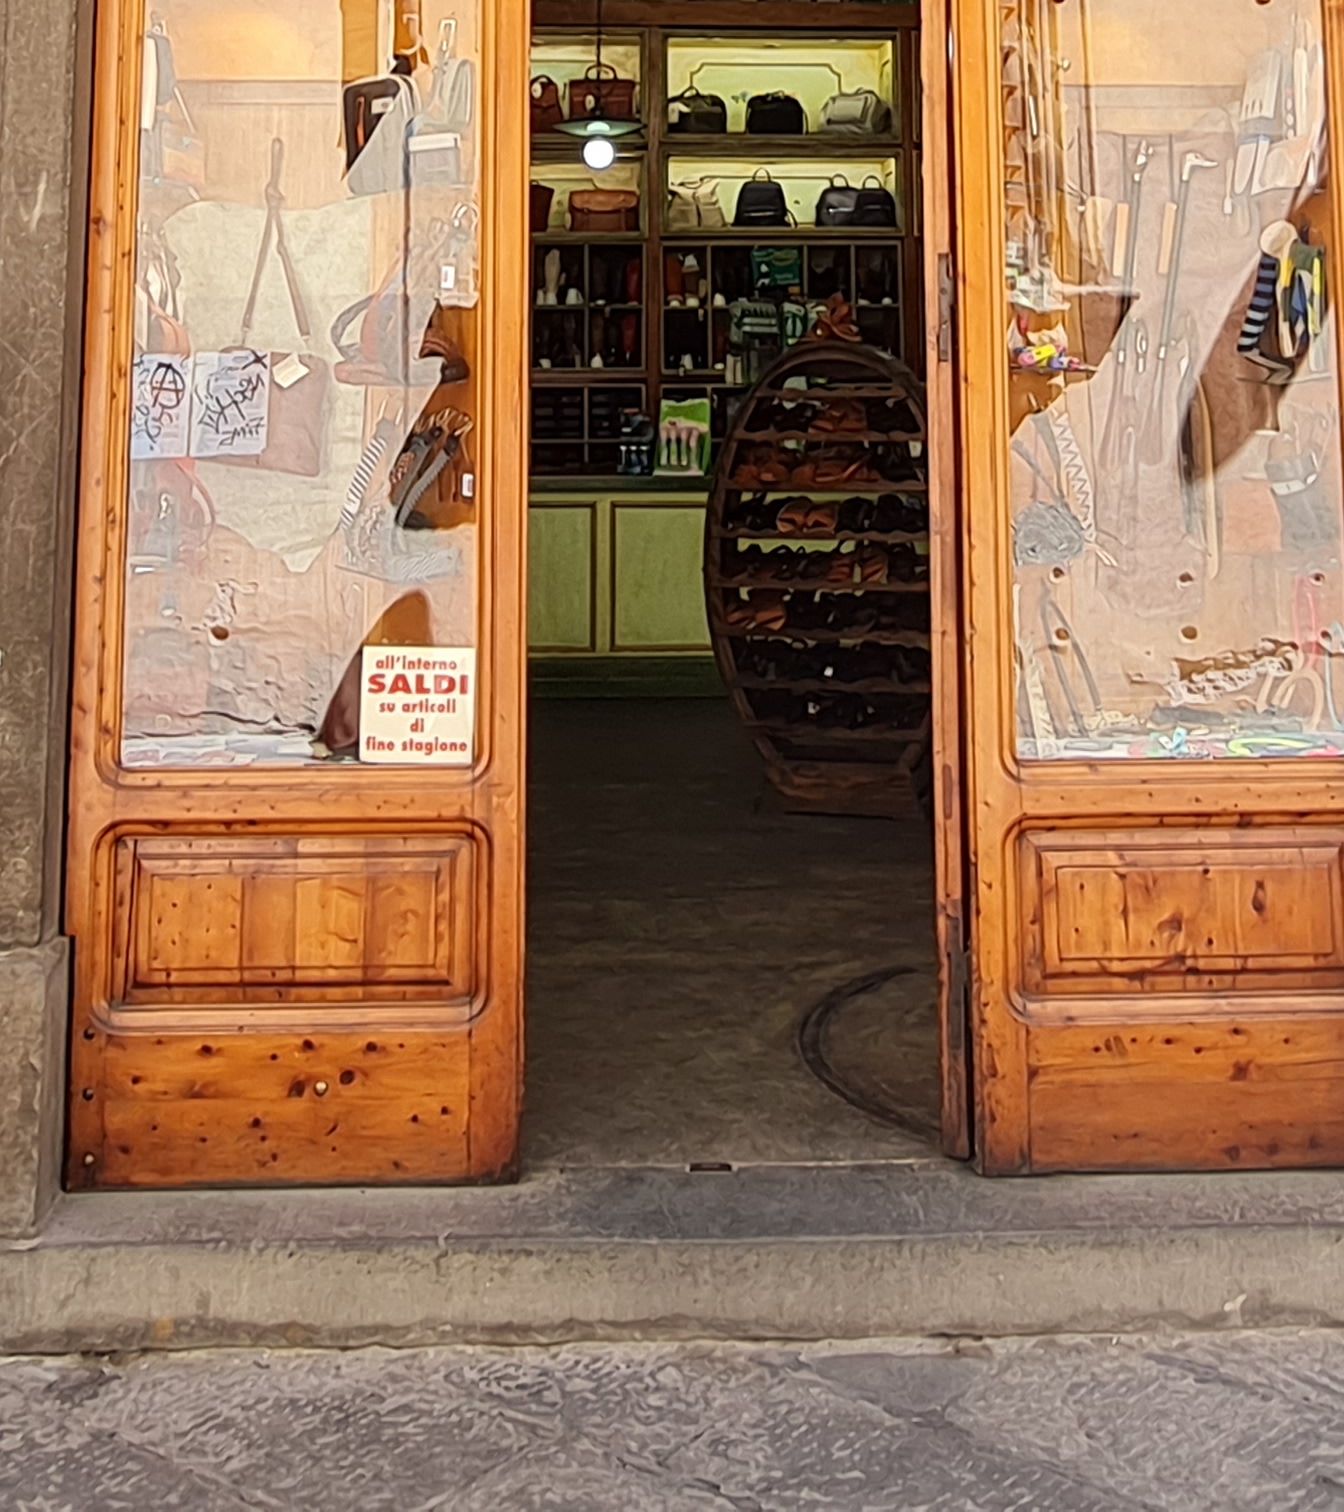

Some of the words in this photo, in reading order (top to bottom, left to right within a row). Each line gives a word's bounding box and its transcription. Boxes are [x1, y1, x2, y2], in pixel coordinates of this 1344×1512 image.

[375, 654, 458, 670] all'interno
[367, 673, 469, 695] SALDI
[379, 702, 396, 713] su
[401, 698, 456, 713] articoli
[410, 717, 425, 733] di
[366, 735, 395, 751] fine
[401, 736, 468, 756] stagione
